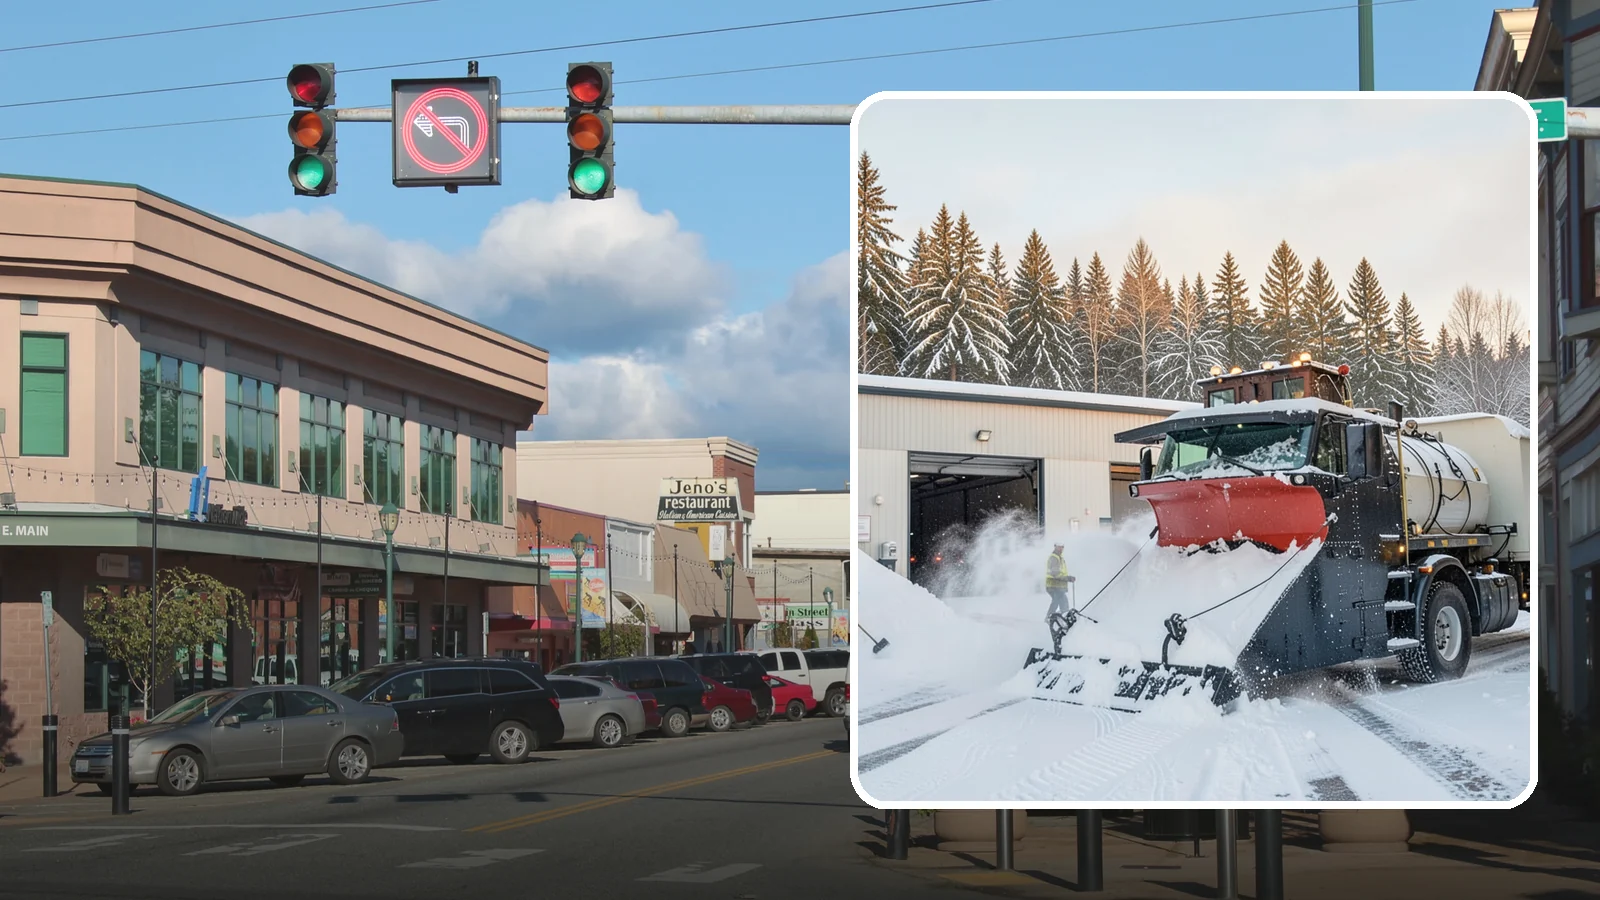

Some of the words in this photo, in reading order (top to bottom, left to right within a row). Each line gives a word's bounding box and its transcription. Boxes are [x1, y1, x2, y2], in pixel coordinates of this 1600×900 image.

[669, 479, 728, 494] Jeno's
[665, 496, 731, 509] restaurant
[685, 509, 714, 519] American
[715, 509, 738, 519] Cuisine
[2, 525, 13, 536] E.
[15, 525, 49, 536] MAIN
[786, 607, 795, 616] in
[797, 607, 828, 617] Street
